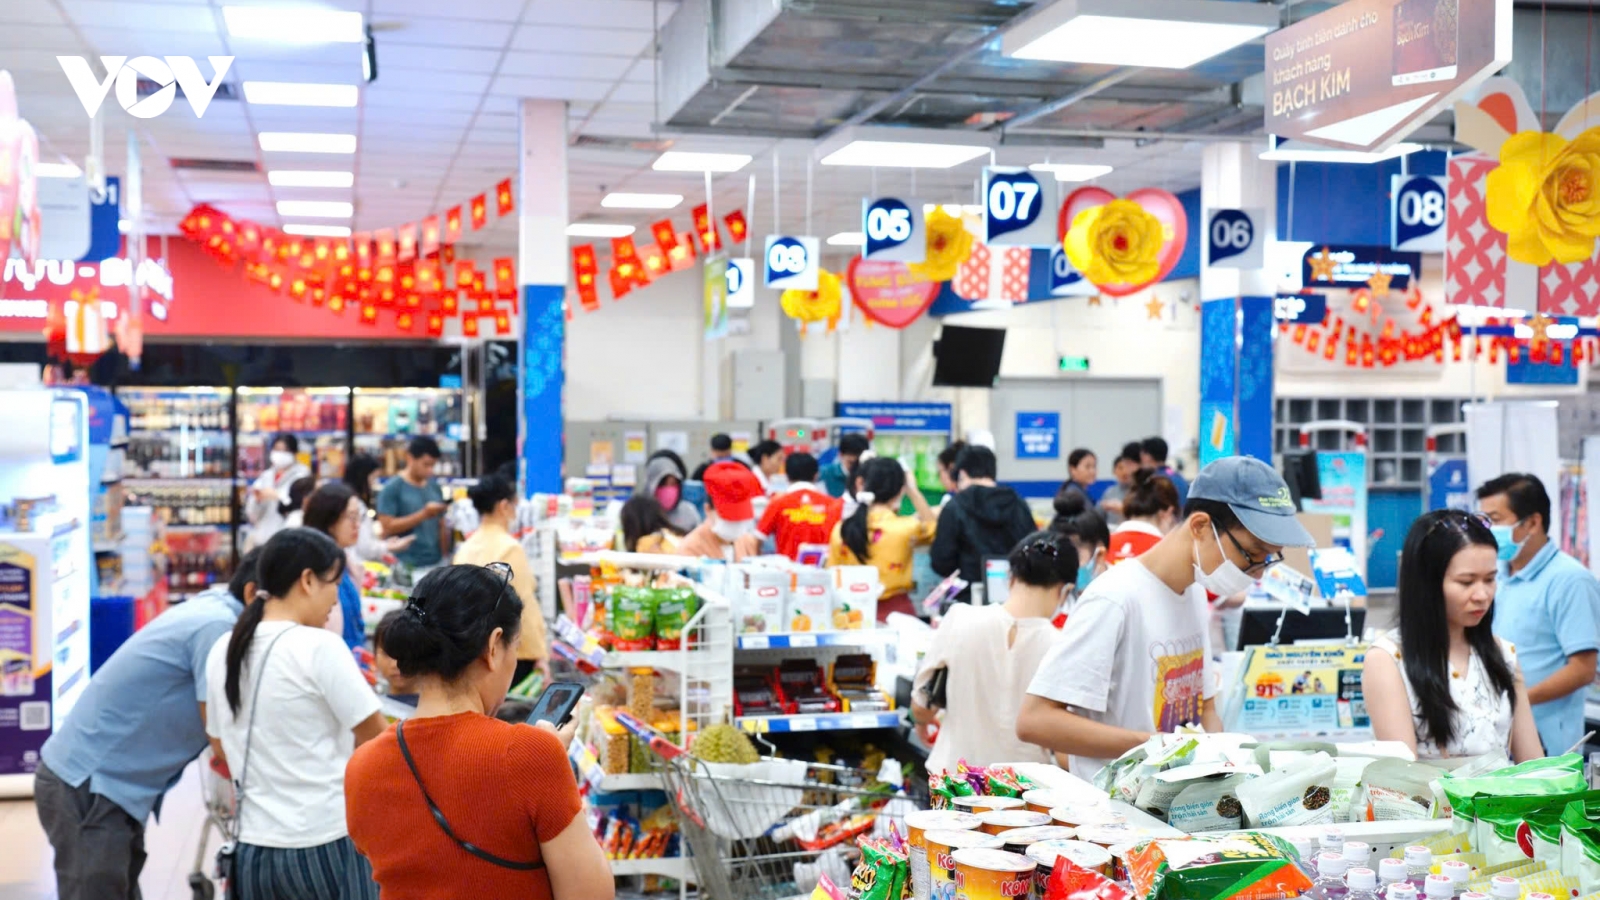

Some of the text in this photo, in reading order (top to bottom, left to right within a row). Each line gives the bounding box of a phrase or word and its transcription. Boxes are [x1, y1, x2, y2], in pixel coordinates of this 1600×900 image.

[1360, 11, 1379, 29] cho
[1273, 67, 1351, 118] BẠCH KIM
[989, 181, 1039, 220] 07
[1400, 190, 1444, 227] 08
[868, 208, 912, 241] 05
[1212, 219, 1251, 248] 06
